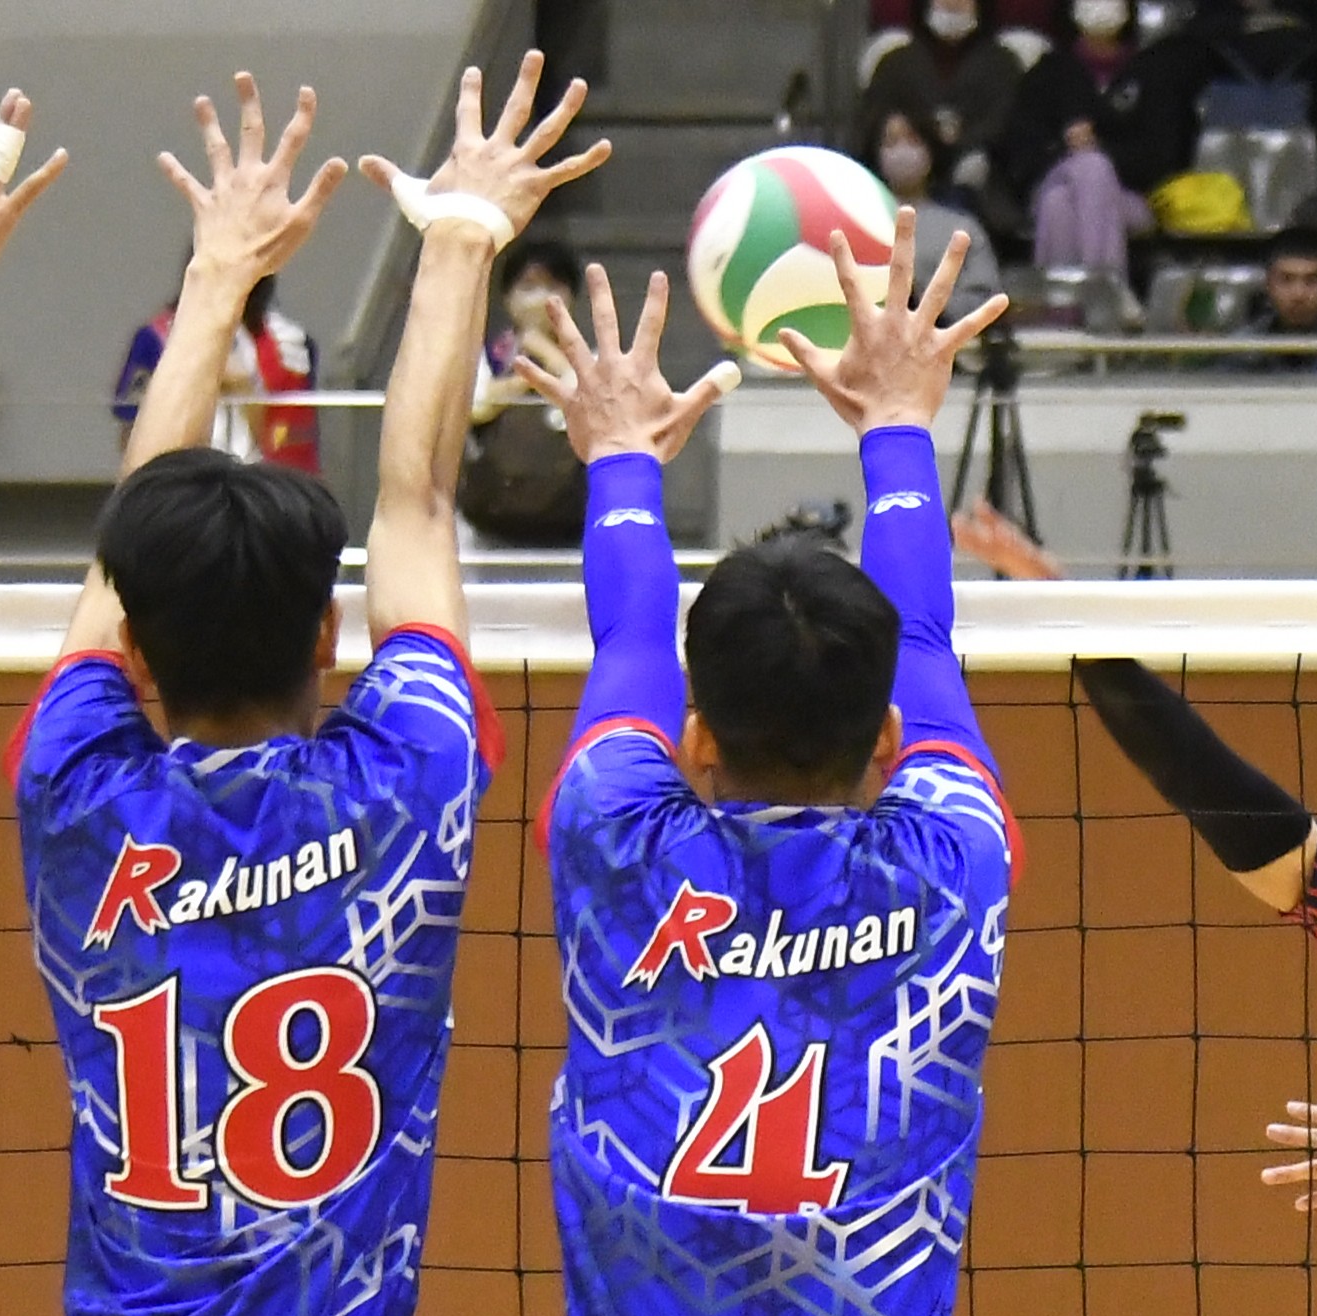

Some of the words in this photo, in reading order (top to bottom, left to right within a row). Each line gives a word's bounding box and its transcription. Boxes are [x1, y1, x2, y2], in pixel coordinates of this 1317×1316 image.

[82, 828, 357, 951] Rakunan
[621, 879, 915, 991] Rakunan
[94, 967, 381, 1210] 18
[662, 1022, 849, 1214] 4
